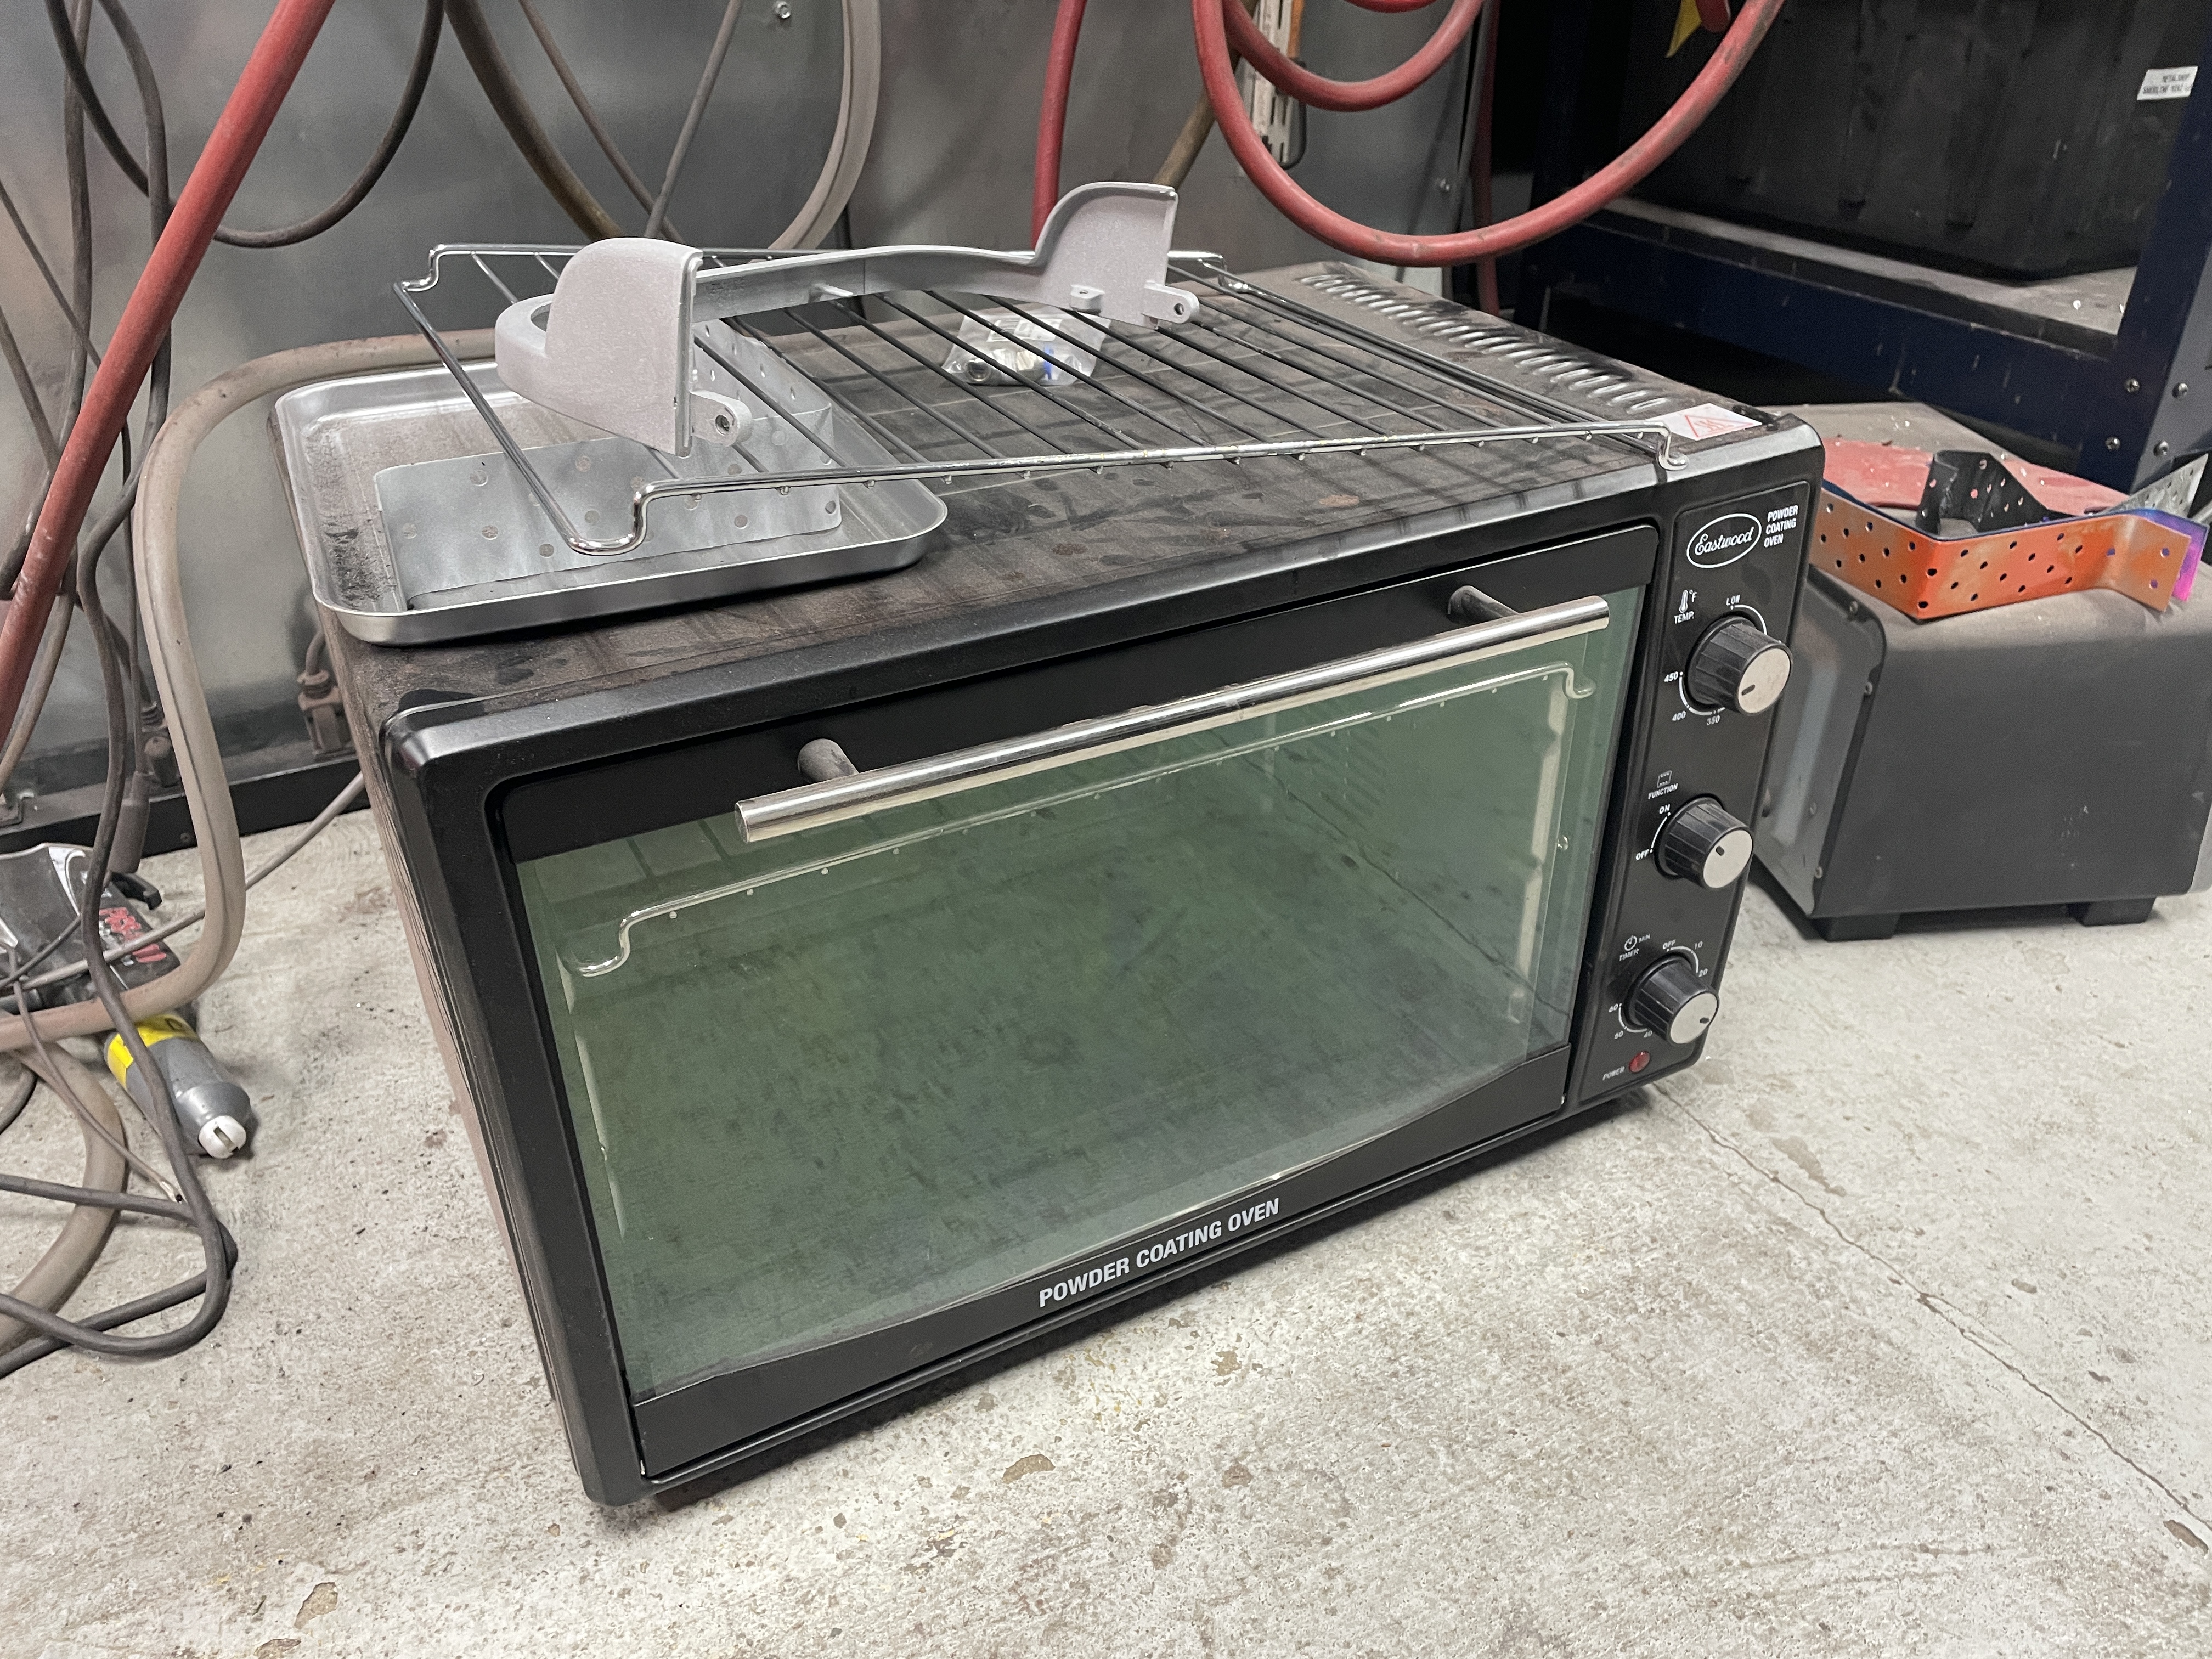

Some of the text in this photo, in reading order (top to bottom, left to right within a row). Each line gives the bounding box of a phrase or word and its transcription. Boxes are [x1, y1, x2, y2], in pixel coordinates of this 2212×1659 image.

[1768, 505, 1798, 522] POWDER
[1765, 518, 1796, 534] COATING
[1694, 526, 1754, 555] Eastwood
[1764, 534, 1784, 548] OVEN
[1726, 594, 1740, 606] LOW
[1664, 671, 1678, 682] 450
[1672, 710, 1686, 721] 400
[1706, 715, 1720, 725] 350
[1647, 783, 1678, 800] FUNCTION
[1659, 804, 1671, 814] ON
[1635, 849, 1649, 861] OFF
[1638, 934, 1651, 943] MIN
[1662, 939, 1676, 950] OFF
[1694, 941, 1703, 950] 10
[1619, 948, 1639, 961] TIMER
[1699, 968, 1708, 977] 20
[1609, 1003, 1618, 1012] 60
[1602, 1066, 1625, 1081] POWER
[1039, 1197, 1280, 1308] POWDER COATING OVEN
